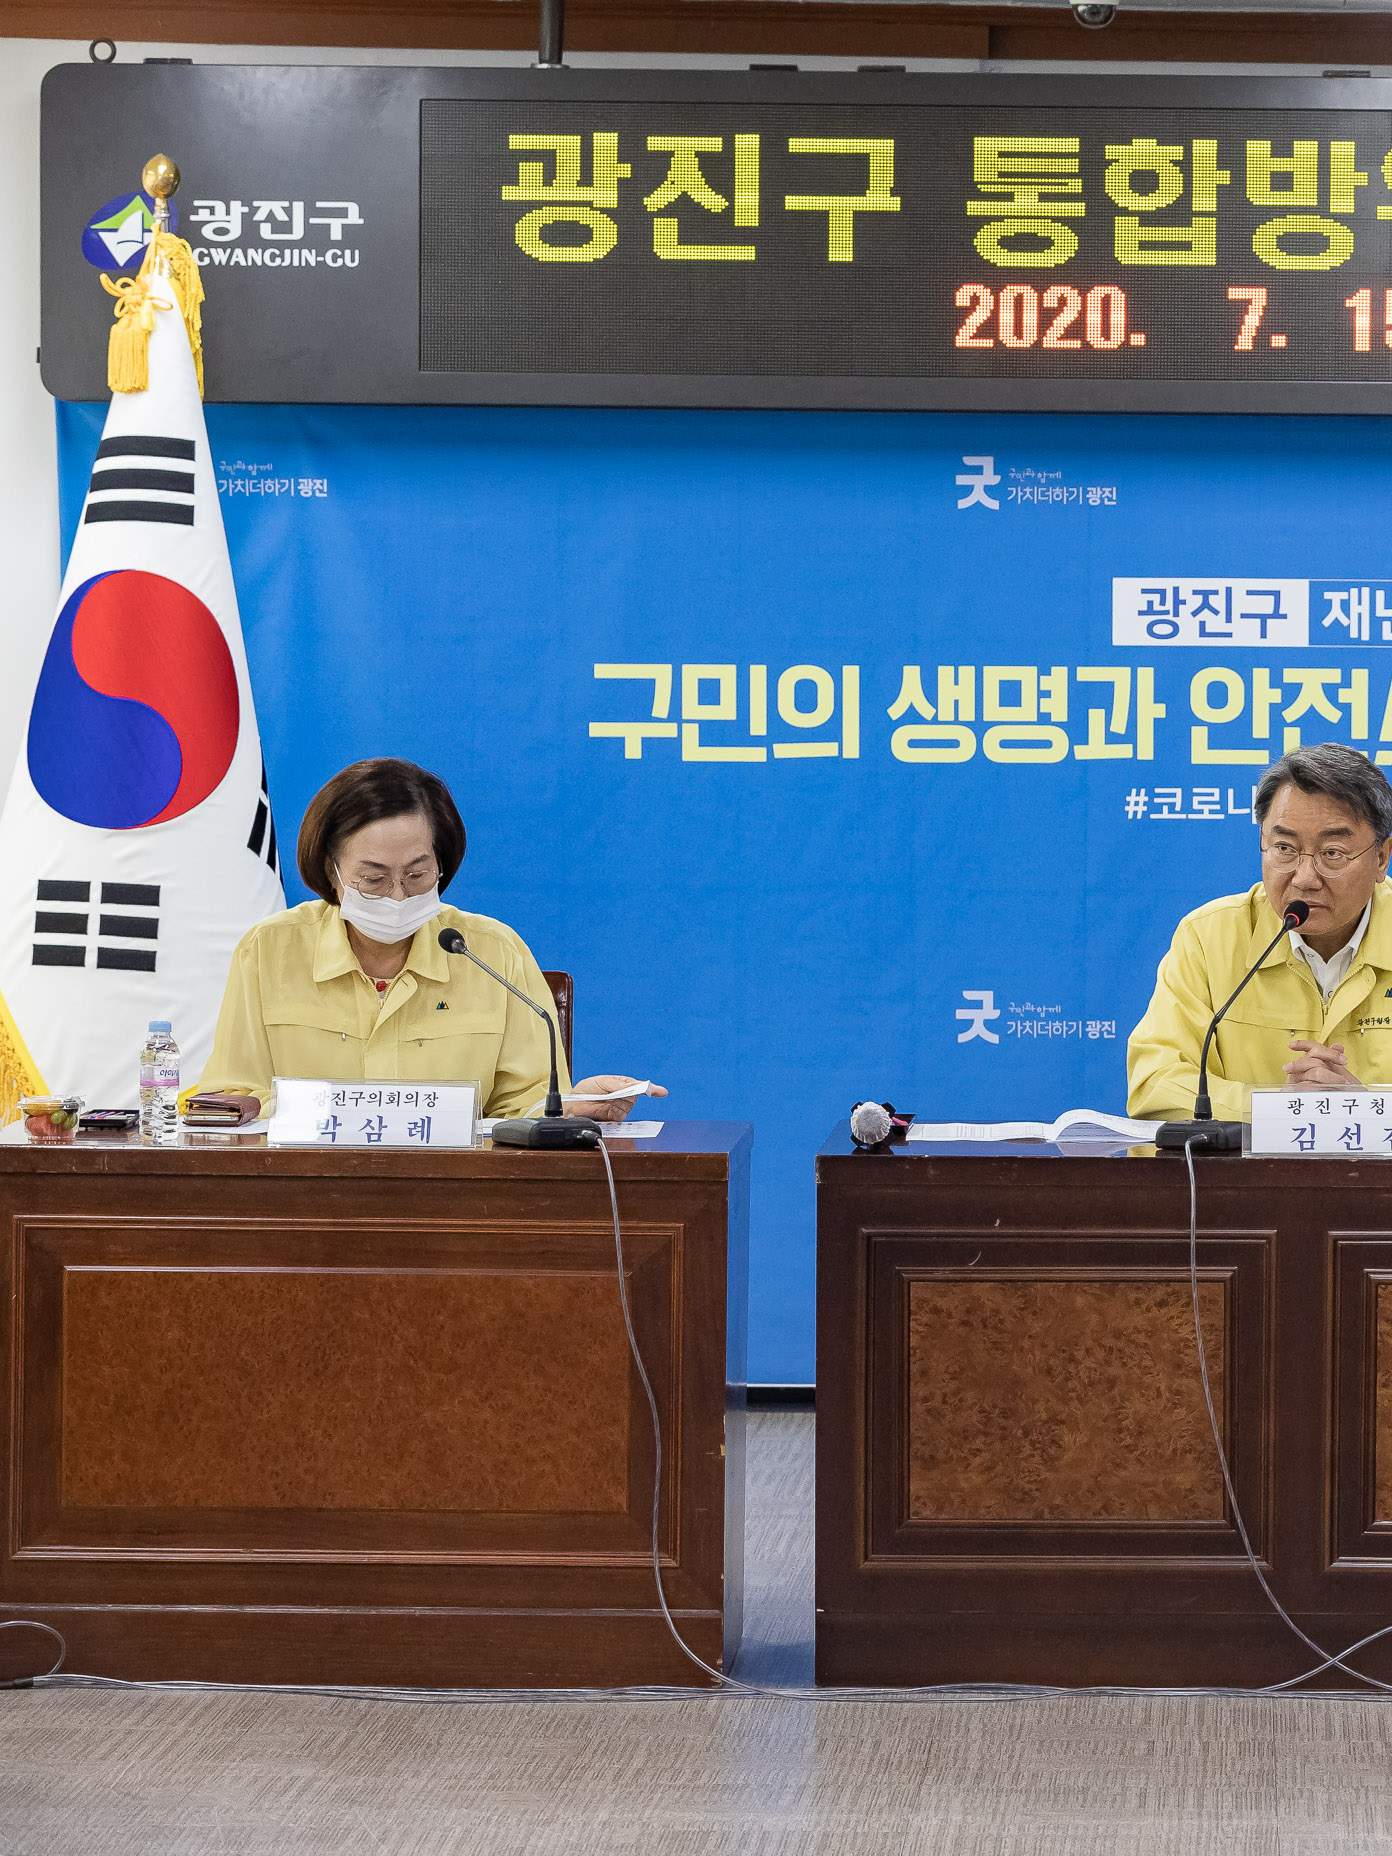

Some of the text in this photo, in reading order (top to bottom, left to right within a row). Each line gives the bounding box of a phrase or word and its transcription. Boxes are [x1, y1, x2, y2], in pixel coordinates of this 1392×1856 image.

[502, 132, 902, 263] 광진구
[189, 200, 365, 242] 광진구
[192, 247, 360, 268] GWANGJIN-GU
[955, 283, 1147, 351] 2020.
[1227, 286, 1288, 351] 7.
[218, 478, 328, 497] 가치더하기 광진
[1007, 486, 1117, 505] 가치더하기 광진
[1137, 585, 1288, 640] 광진구
[589, 664, 859, 762] 구민의
[887, 667, 1165, 763] 생명과
[1007, 1020, 1116, 1039] 가치더하기 광진
